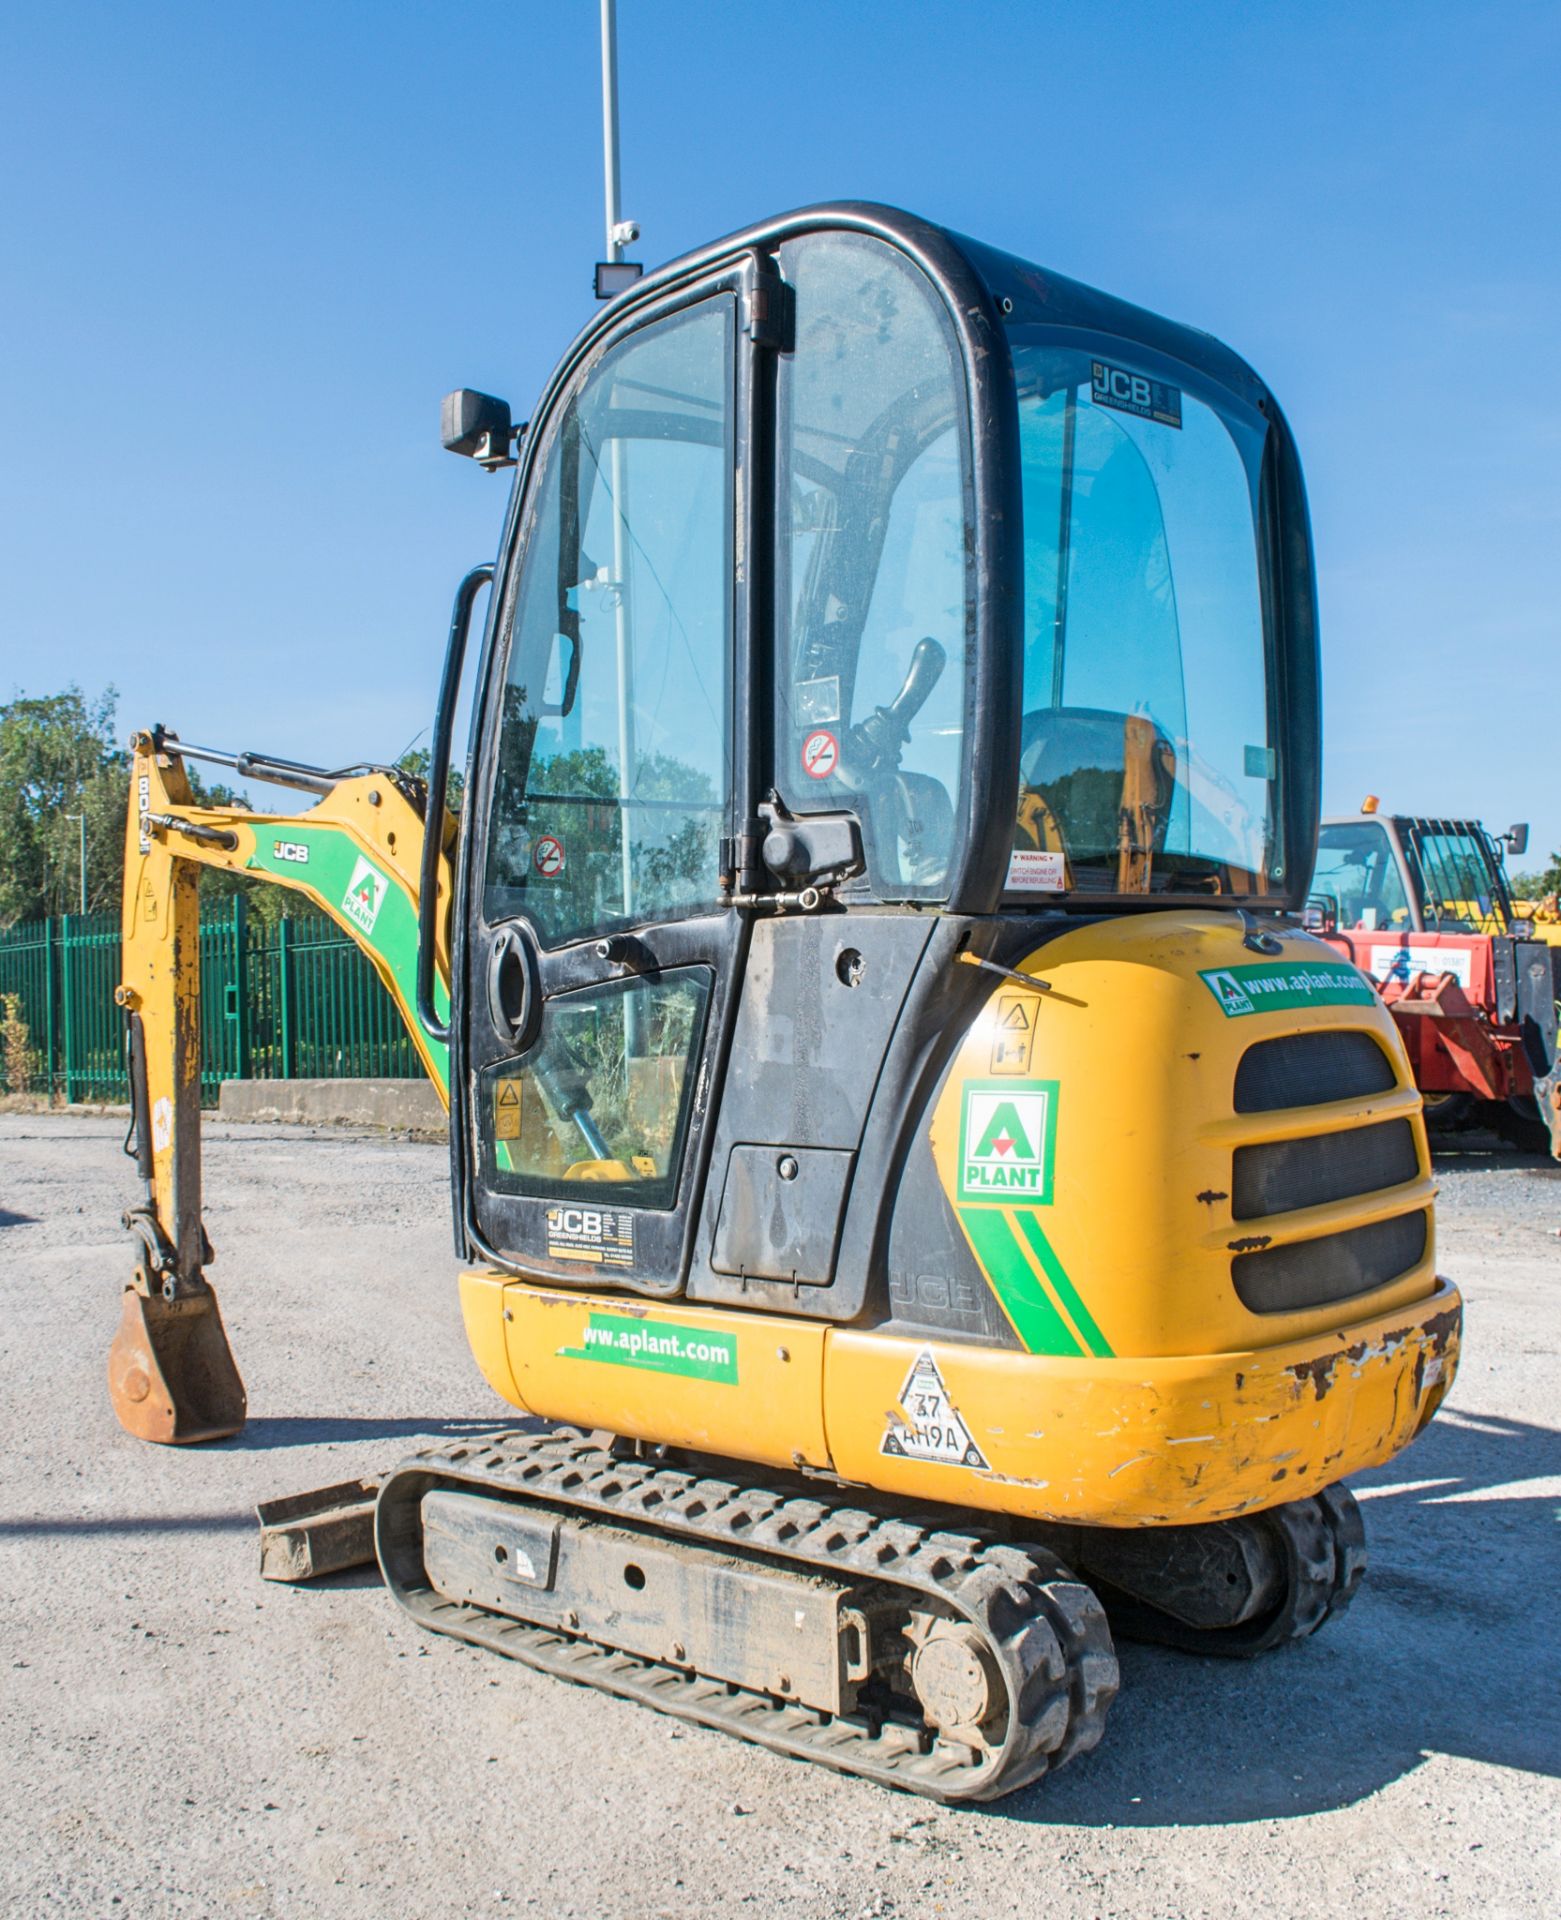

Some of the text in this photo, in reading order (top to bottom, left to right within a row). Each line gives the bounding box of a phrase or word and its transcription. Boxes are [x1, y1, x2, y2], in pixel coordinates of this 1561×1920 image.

[1093, 366, 1151, 407] JCB
[273, 840, 308, 863] JCB
[1020, 854, 1048, 862] WARNING
[352, 872, 377, 914] A
[344, 896, 373, 929] PLANT
[1216, 976, 1246, 1000] A
[1243, 970, 1366, 995] www.aplant.com
[1224, 1000, 1250, 1012] PLANT
[974, 1102, 1035, 1158] A
[967, 1166, 1040, 1187] PLANT
[548, 1209, 601, 1235] JCB
[548, 1231, 601, 1243] GREENSHIELDS
[914, 1393, 940, 1417] 37
